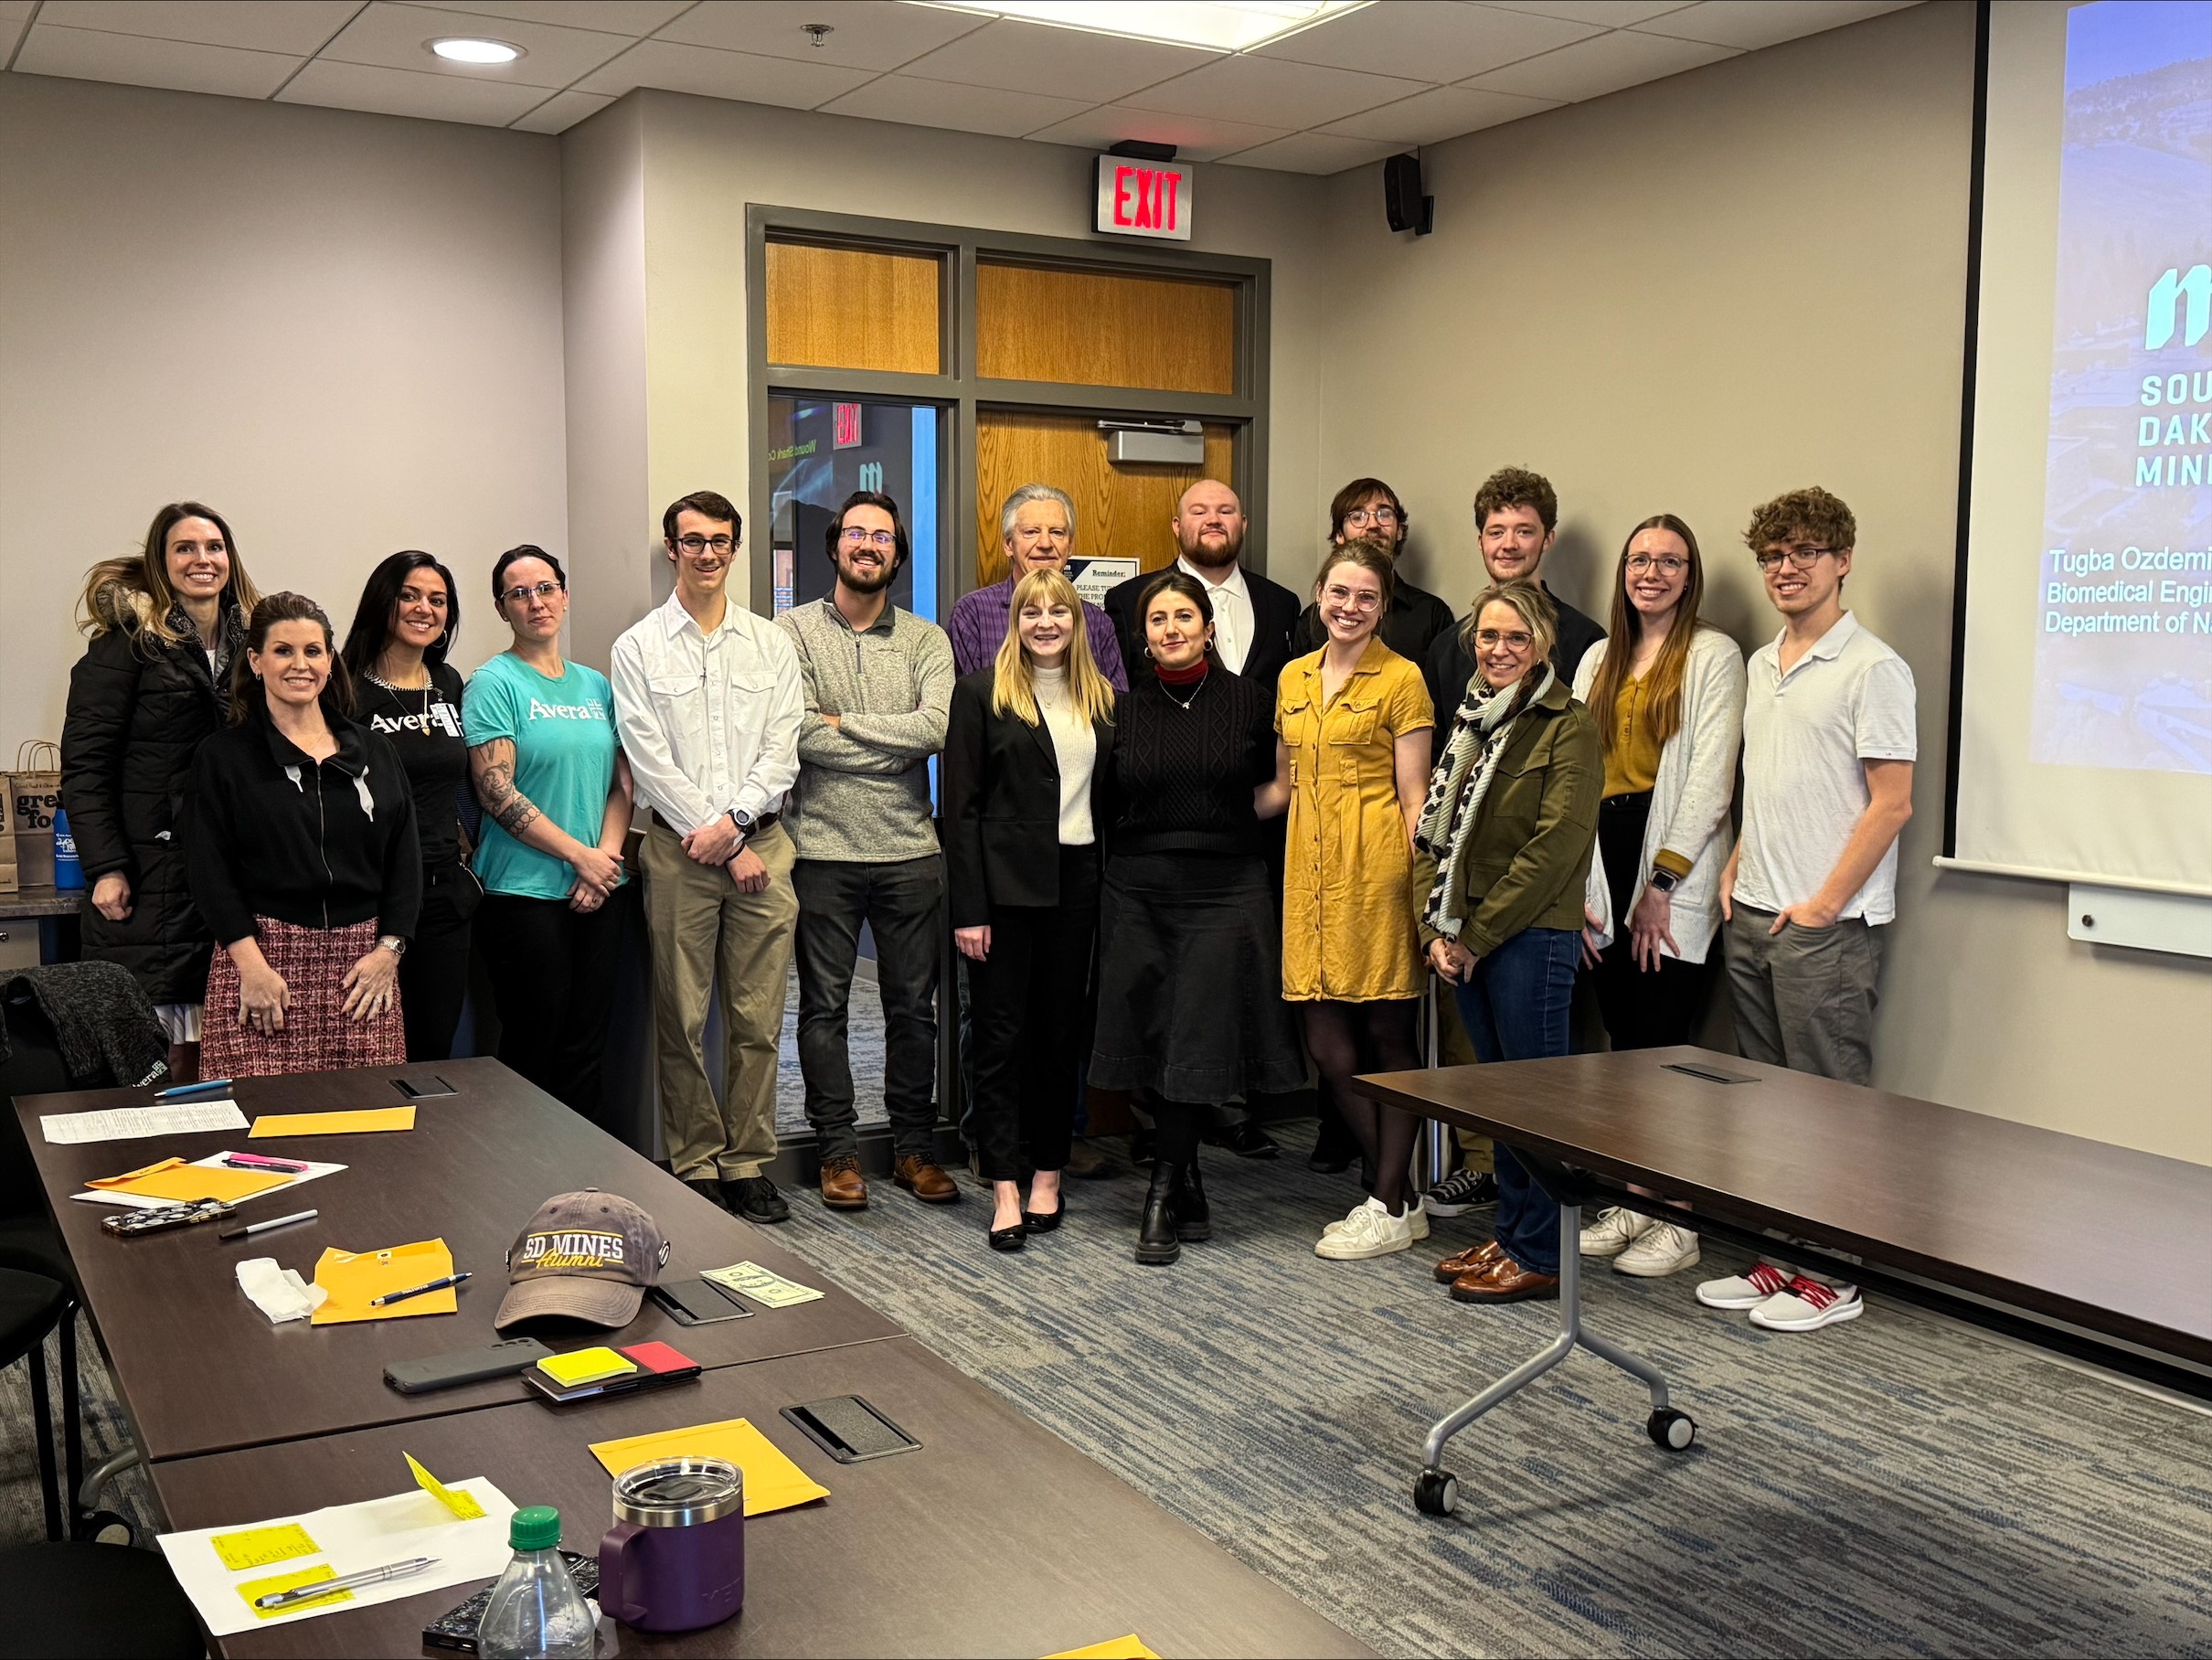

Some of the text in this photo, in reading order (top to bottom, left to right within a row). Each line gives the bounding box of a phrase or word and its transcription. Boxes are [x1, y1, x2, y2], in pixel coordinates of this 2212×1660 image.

[1113, 165, 1182, 231] EXIT
[837, 402, 858, 445] EXIT
[2138, 412, 2212, 446] DAK
[1091, 569, 1126, 578] Reminder:
[2049, 546, 2212, 578] Tugba Ozdemi
[2047, 580, 2154, 604] Biomedical
[2045, 611, 2160, 637] Department
[2164, 611, 2187, 633] of
[529, 697, 592, 720] Avera
[523, 1234, 624, 1261] SD MINES
[536, 1248, 603, 1269] Alumni
